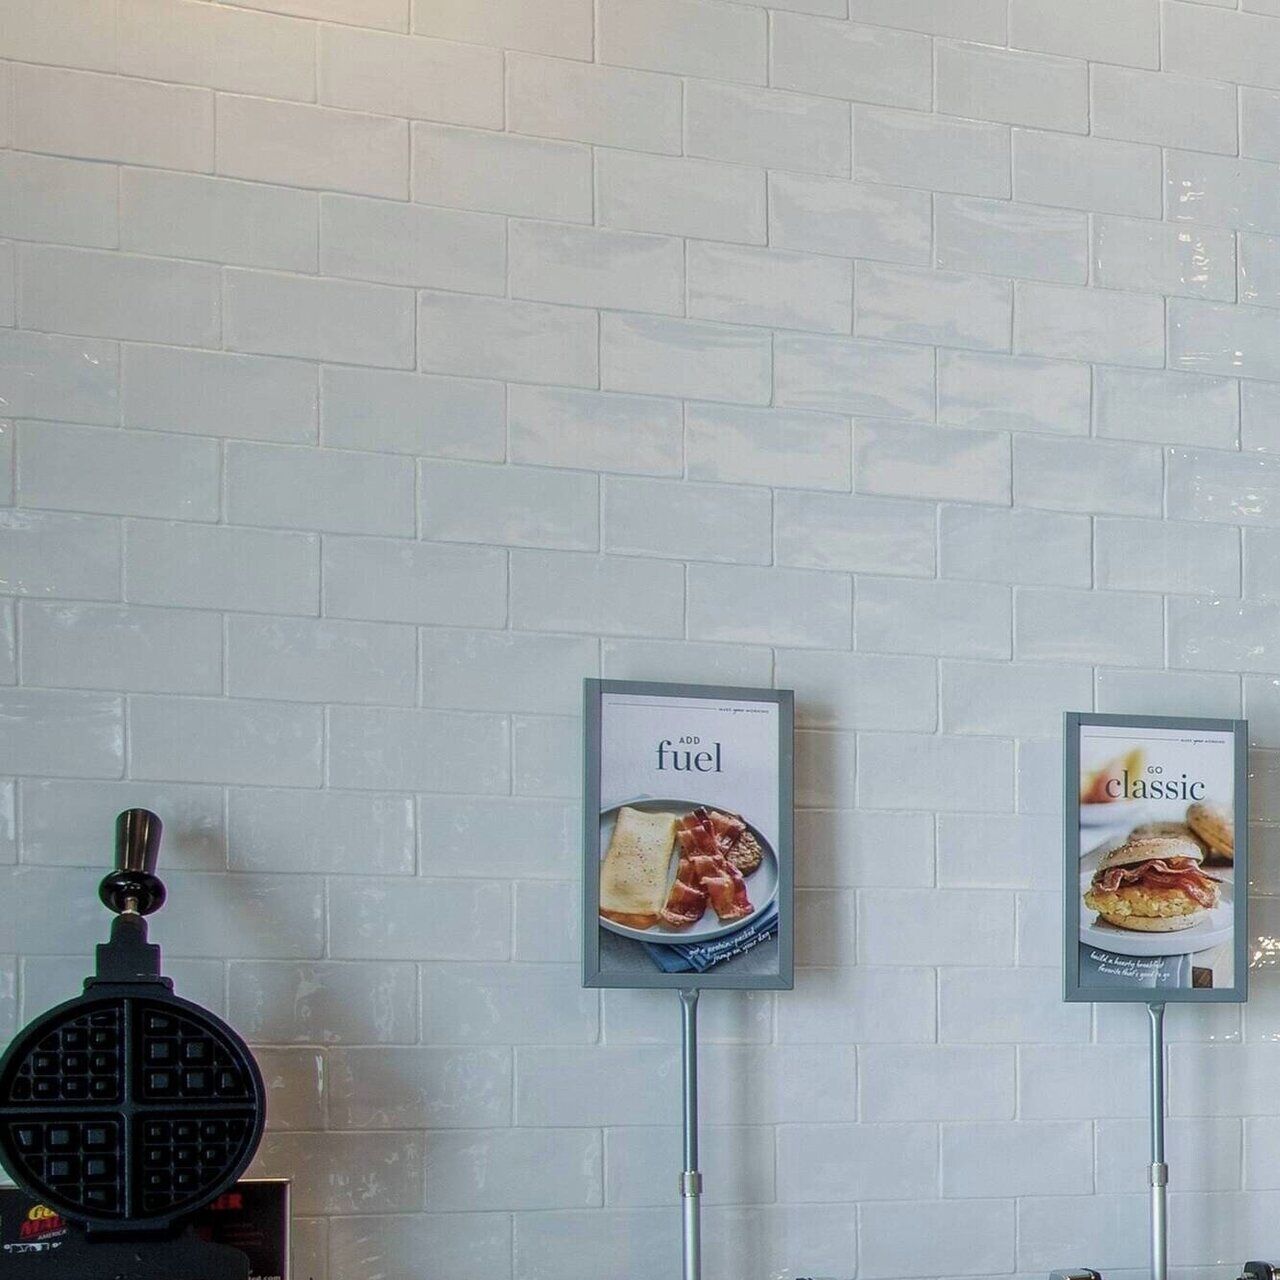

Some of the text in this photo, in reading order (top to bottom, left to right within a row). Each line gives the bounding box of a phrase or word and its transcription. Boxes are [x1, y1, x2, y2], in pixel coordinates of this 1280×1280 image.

[679, 736, 700, 745] ADD
[656, 739, 723, 773] fuel
[1147, 766, 1163, 775] GO
[1105, 769, 1205, 801] classic
